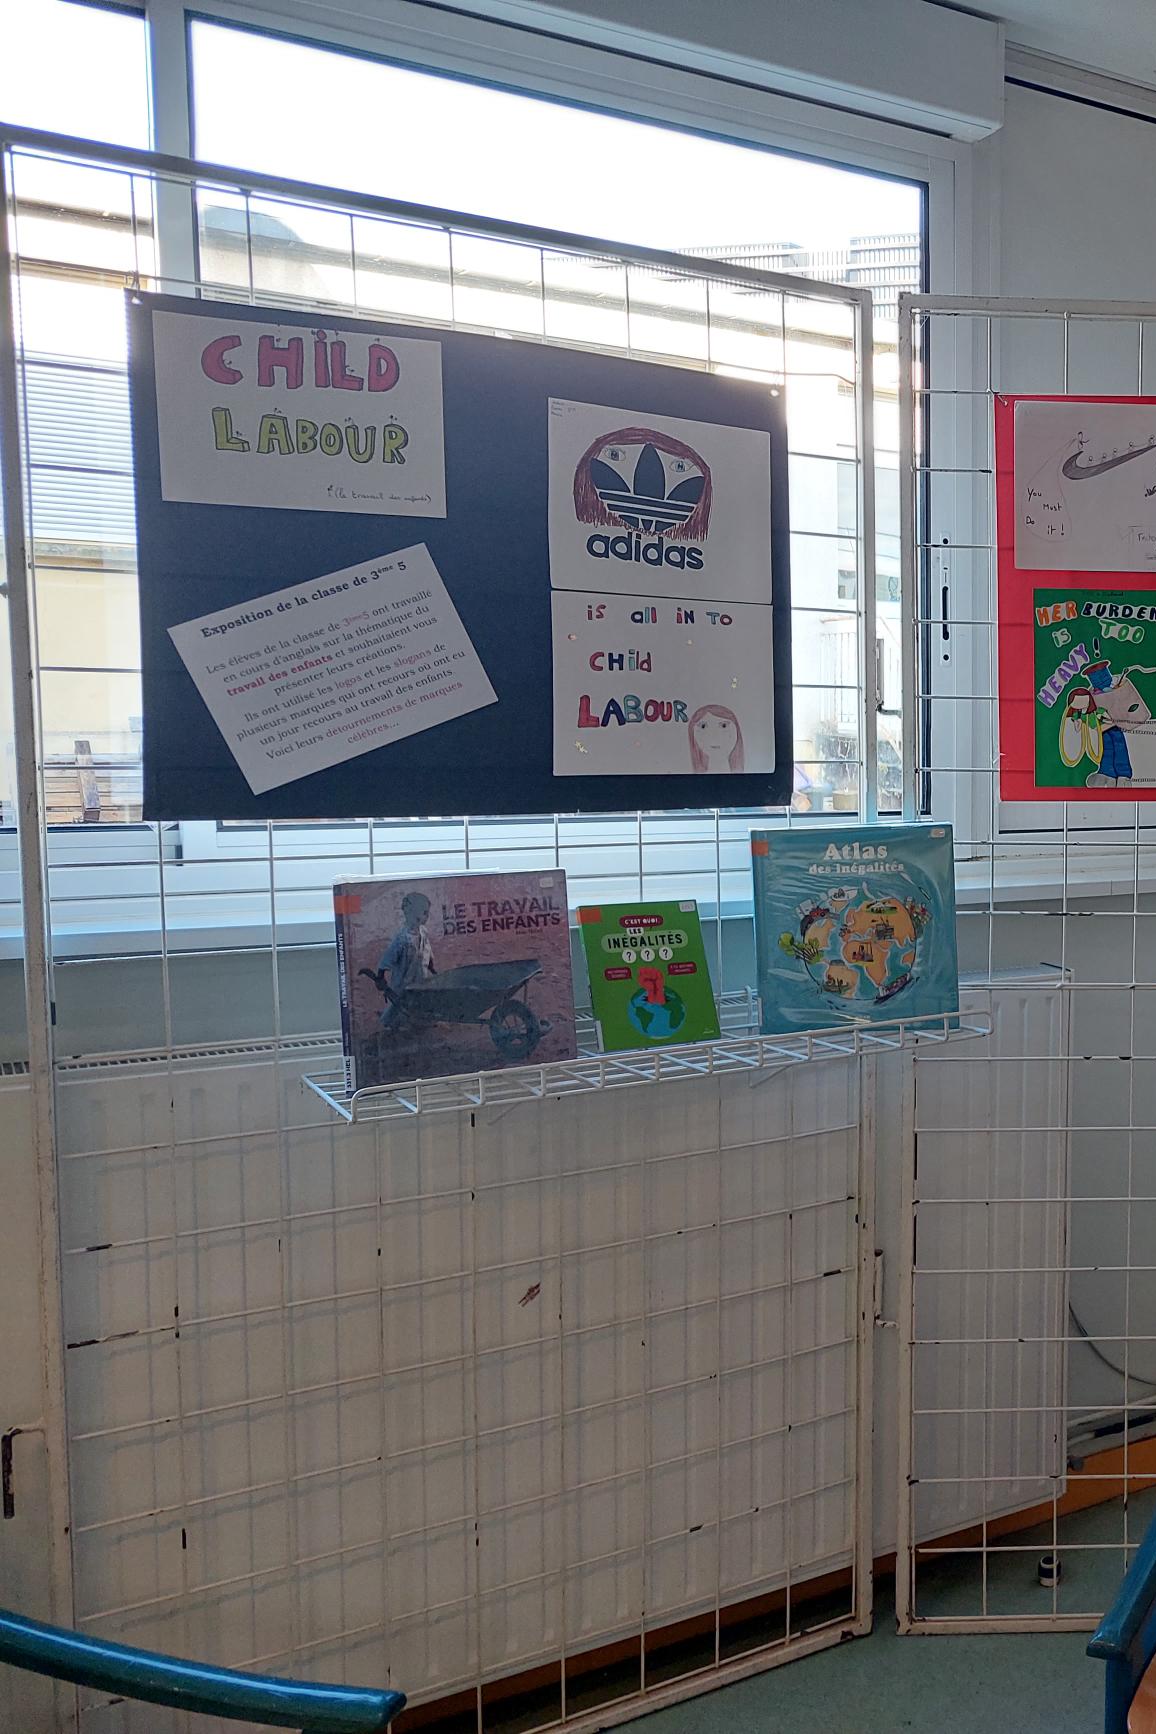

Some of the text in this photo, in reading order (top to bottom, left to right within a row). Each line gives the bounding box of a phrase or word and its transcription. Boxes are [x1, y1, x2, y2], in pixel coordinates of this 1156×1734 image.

[201, 329, 400, 392] CHILD
[212, 406, 409, 464] LABOUR
[1027, 487, 1042, 501] You
[586, 531, 705, 570] adidas
[200, 606, 273, 640] Exposition
[275, 600, 291, 612] de
[294, 595, 308, 605] la
[310, 580, 349, 600] classe
[351, 574, 367, 586] de
[397, 561, 406, 570] 5
[1036, 601, 1077, 626] HER
[631, 607, 657, 625] all
[1099, 619, 1145, 643] TOO
[226, 617, 437, 697] travail des enfants et souhaitaient vous
[1037, 643, 1090, 708] HEAVY
[577, 694, 689, 728] LABOUR
[823, 842, 888, 860] Atlas
[808, 863, 831, 875] des
[442, 896, 561, 921] LE TRAVAIL
[443, 911, 561, 937] DES ENFANTS
